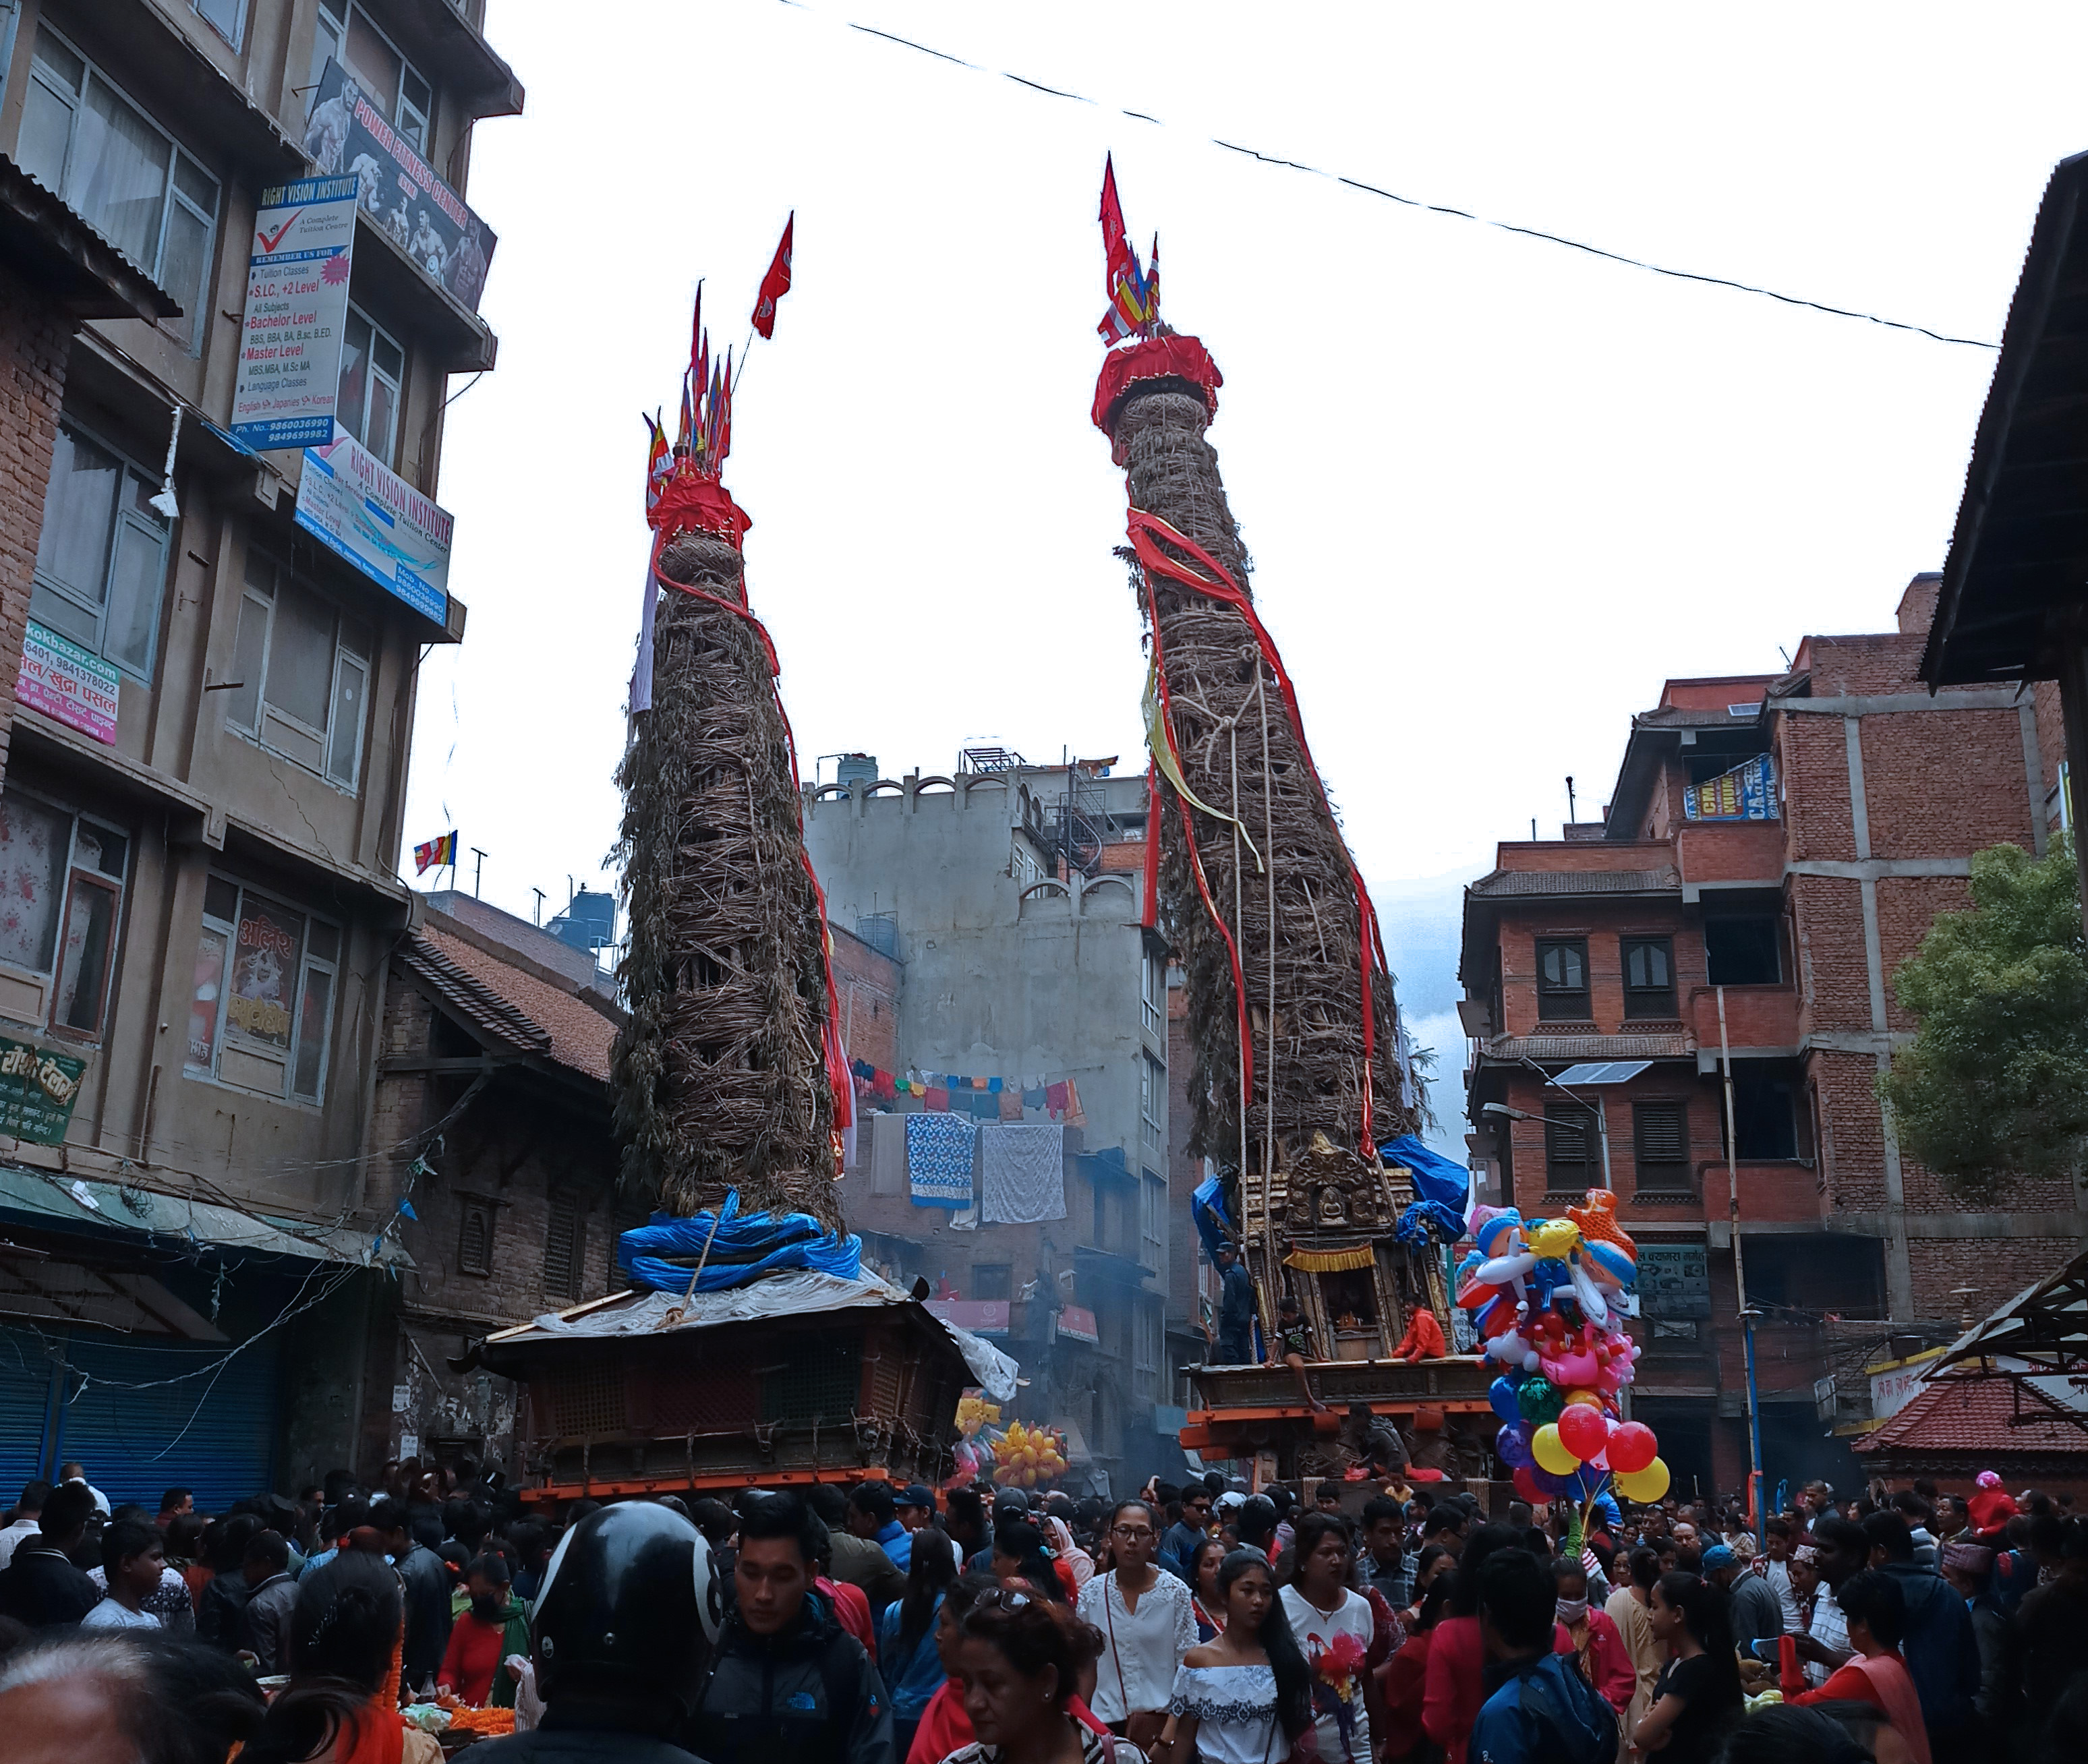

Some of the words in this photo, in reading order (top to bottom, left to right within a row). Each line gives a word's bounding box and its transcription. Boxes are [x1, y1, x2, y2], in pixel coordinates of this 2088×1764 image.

[354, 96, 395, 152] POWER
[391, 136, 434, 193] FITNESS
[432, 180, 468, 231] CENTER
[261, 186, 286, 206] RIGHT
[288, 182, 316, 203] VISION
[316, 177, 357, 200] INSTITUTE
[307, 214, 339, 225] Complete
[256, 252, 301, 264] REMEMBER
[304, 250, 314, 259] US
[317, 249, 333, 258] FOR
[260, 269, 281, 278] Tuition
[283, 266, 309, 276] Classes
[282, 282, 293, 295] +2
[295, 279, 319, 293] Level
[254, 303, 262, 314] All
[263, 302, 289, 314] Subjects
[250, 316, 291, 329] Bachelor
[293, 310, 317, 325] Level
[250, 334, 264, 345] BBS,
[267, 332, 281, 343] BBA,
[284, 331, 294, 342] BA,
[247, 346, 277, 360] Master
[280, 343, 303, 357] Level
[300, 361, 310, 371] MA
[248, 381, 279, 392] Language
[281, 378, 307, 388] Classes
[238, 401, 260, 414] English
[312, 394, 334, 404] Korean
[268, 430, 328, 442] 9849699982
[351, 444, 374, 486] RIGHT
[377, 467, 405, 512] VISION
[409, 493, 450, 544] INSTITUTE
[365, 486, 397, 517] Complete
[399, 512, 423, 536] Tuition
[425, 533, 448, 554] Center
[23, 640, 53, 666] 6401,
[56, 656, 115, 696] 9841378022
[82, 686, 117, 715] पसल
[1722, 774, 1737, 813] KUUM
[1747, 796, 1765, 820] CA
